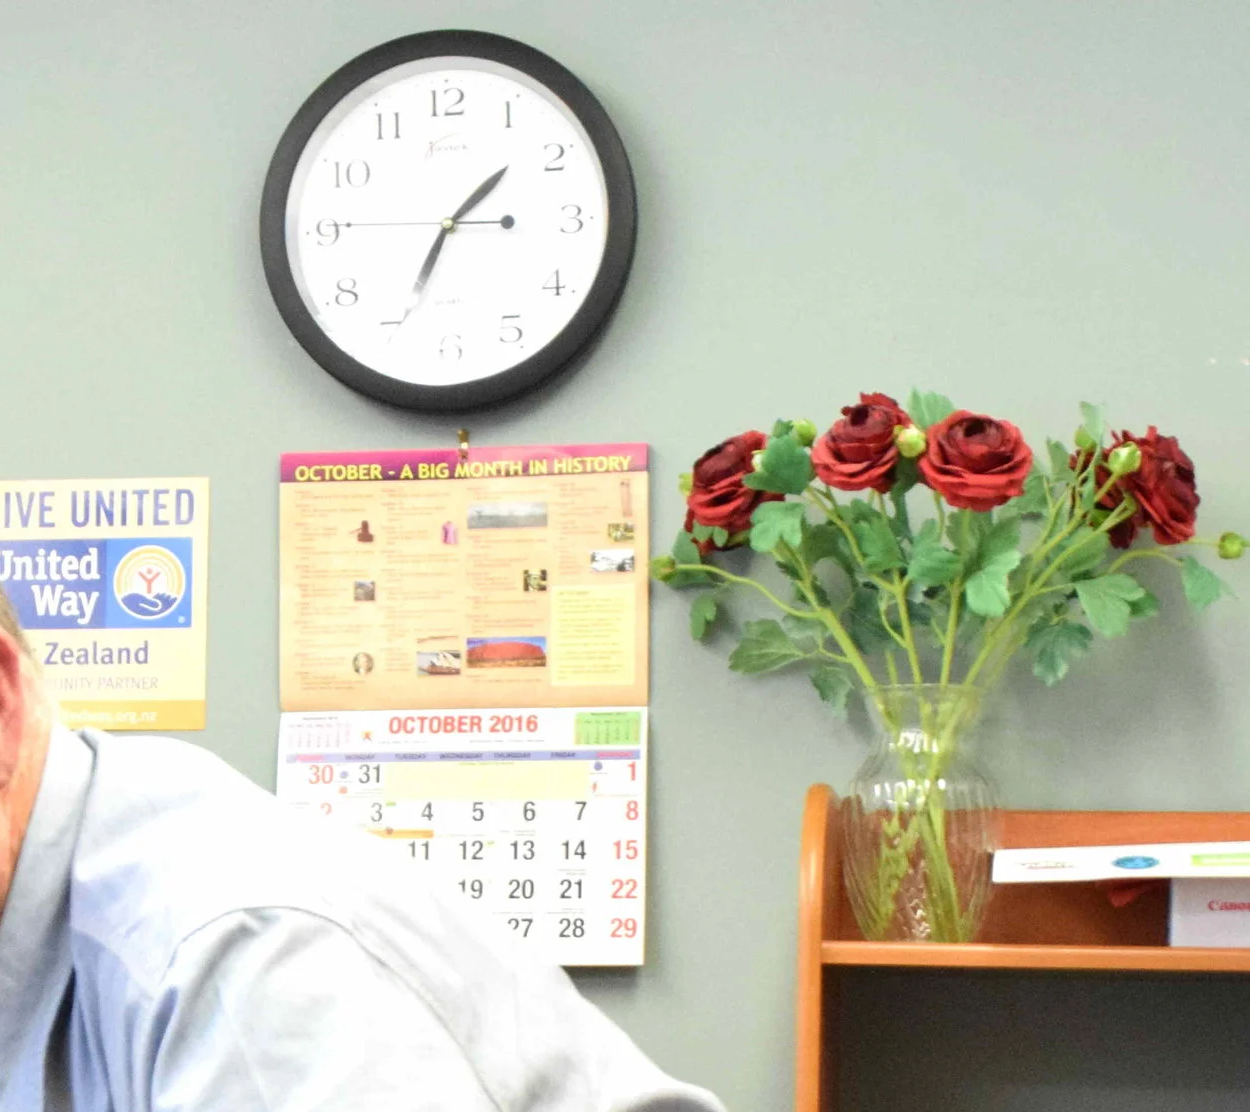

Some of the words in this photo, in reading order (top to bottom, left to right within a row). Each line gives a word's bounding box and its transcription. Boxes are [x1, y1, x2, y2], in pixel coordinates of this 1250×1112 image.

[430, 87, 465, 117] 12
[504, 101, 513, 129] 1
[376, 112, 401, 140] 11
[544, 143, 565, 171] 2
[334, 159, 371, 188] 10
[316, 218, 341, 246] 9
[560, 204, 584, 234] 3
[335, 278, 359, 306] 8
[542, 269, 566, 297] 4
[499, 315, 524, 343] 5
[439, 333, 463, 362] 6
[295, 465, 382, 481] OCTOBER
[400, 463, 414, 479] A
[418, 462, 449, 478] BIG
[455, 458, 522, 477] MONTH
[529, 458, 547, 474] IN
[554, 455, 632, 473] HISTORY
[71, 488, 195, 528] UNITED
[31, 584, 100, 624] Way
[44, 640, 149, 665] Zealand
[53, 677, 93, 690] UNITY
[98, 676, 159, 690] PARTNER
[388, 715, 482, 735] OCTOBER
[488, 714, 539, 734] 2016
[308, 765, 334, 784] 30
[358, 764, 382, 784] 31
[628, 761, 638, 781] 1
[371, 802, 383, 822] 3
[421, 802, 434, 821] 4
[472, 802, 485, 821] 5
[523, 801, 536, 821] 6
[574, 801, 587, 821] 7
[626, 800, 639, 821] 8
[408, 841, 431, 860] 11
[459, 840, 485, 860] 12
[510, 840, 536, 860] 13
[561, 840, 587, 860] 14
[613, 840, 639, 860] 15
[458, 879, 484, 899] 19
[508, 879, 535, 900] 20
[559, 879, 583, 899] 21
[611, 878, 638, 899] 22
[559, 918, 586, 938] 28
[610, 918, 637, 938] 29
